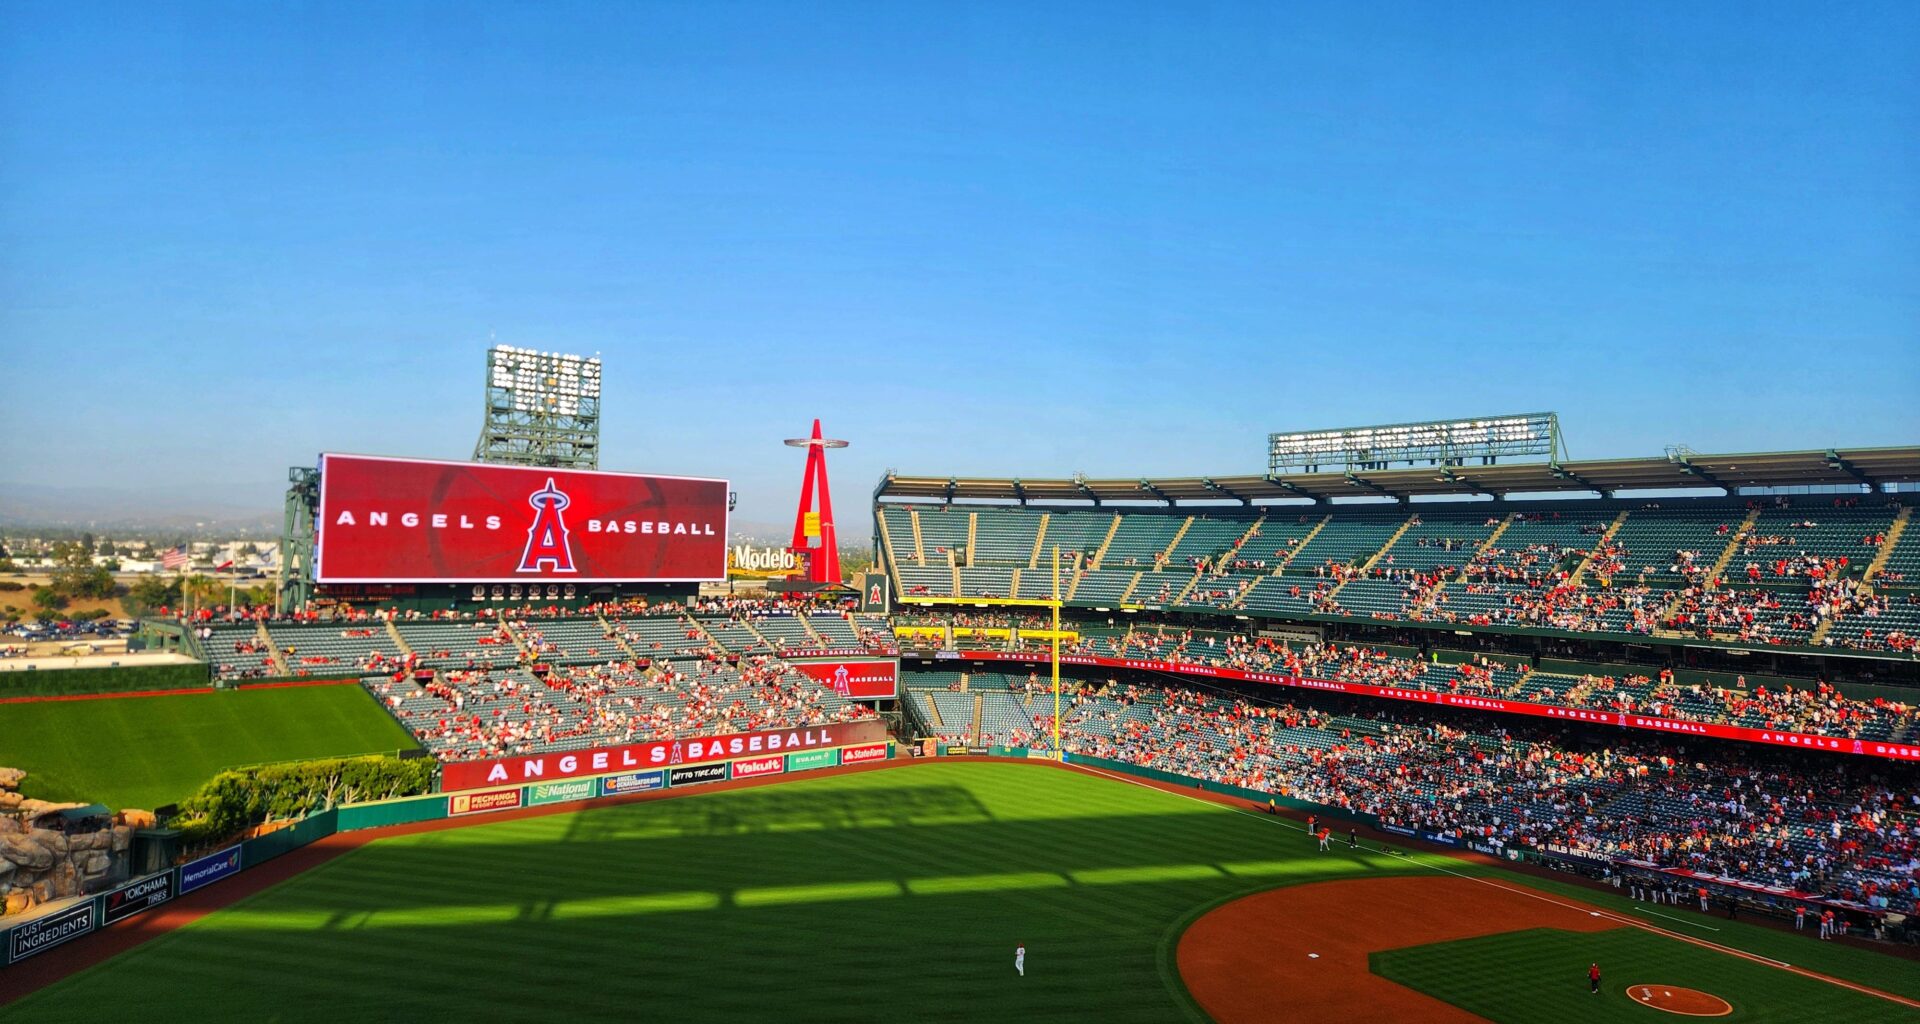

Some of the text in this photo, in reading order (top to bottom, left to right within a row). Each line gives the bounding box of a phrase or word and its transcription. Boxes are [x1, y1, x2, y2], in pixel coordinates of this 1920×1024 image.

[336, 477, 715, 572] ANGELS A BASEBALL
[735, 545, 794, 570] Modelo
[1126, 661, 1164, 669] ANGELS
[1180, 666, 1217, 675] BASEBALL
[1244, 673, 1284, 683] ANGELS
[1301, 680, 1346, 690] BASEBALL
[1379, 689, 1428, 700] ANGELS
[1450, 697, 1504, 709] BASEBALL
[1547, 708, 1608, 721] ANGELS
[1637, 718, 1706, 733] BASEBALL
[1762, 733, 1839, 748] ANGELS
[487, 746, 666, 782] ANGELS
[688, 729, 832, 758] BASEBALL
[672, 766, 725, 781] NITTO TIRE.COM
[736, 759, 780, 774] Yakult
[548, 781, 590, 796] National
[471, 792, 517, 804] PECHANGA
[471, 801, 493, 809] RESORT
[1475, 843, 1494, 854] Modelo
[1547, 843, 1613, 861] MLB NETWOR
[184, 860, 228, 884] MemorialCare
[124, 876, 168, 900] YOKOHAMA
[147, 890, 167, 905] TIRES
[19, 921, 43, 939] JUST
[19, 915, 88, 952] INGREDIENTS
